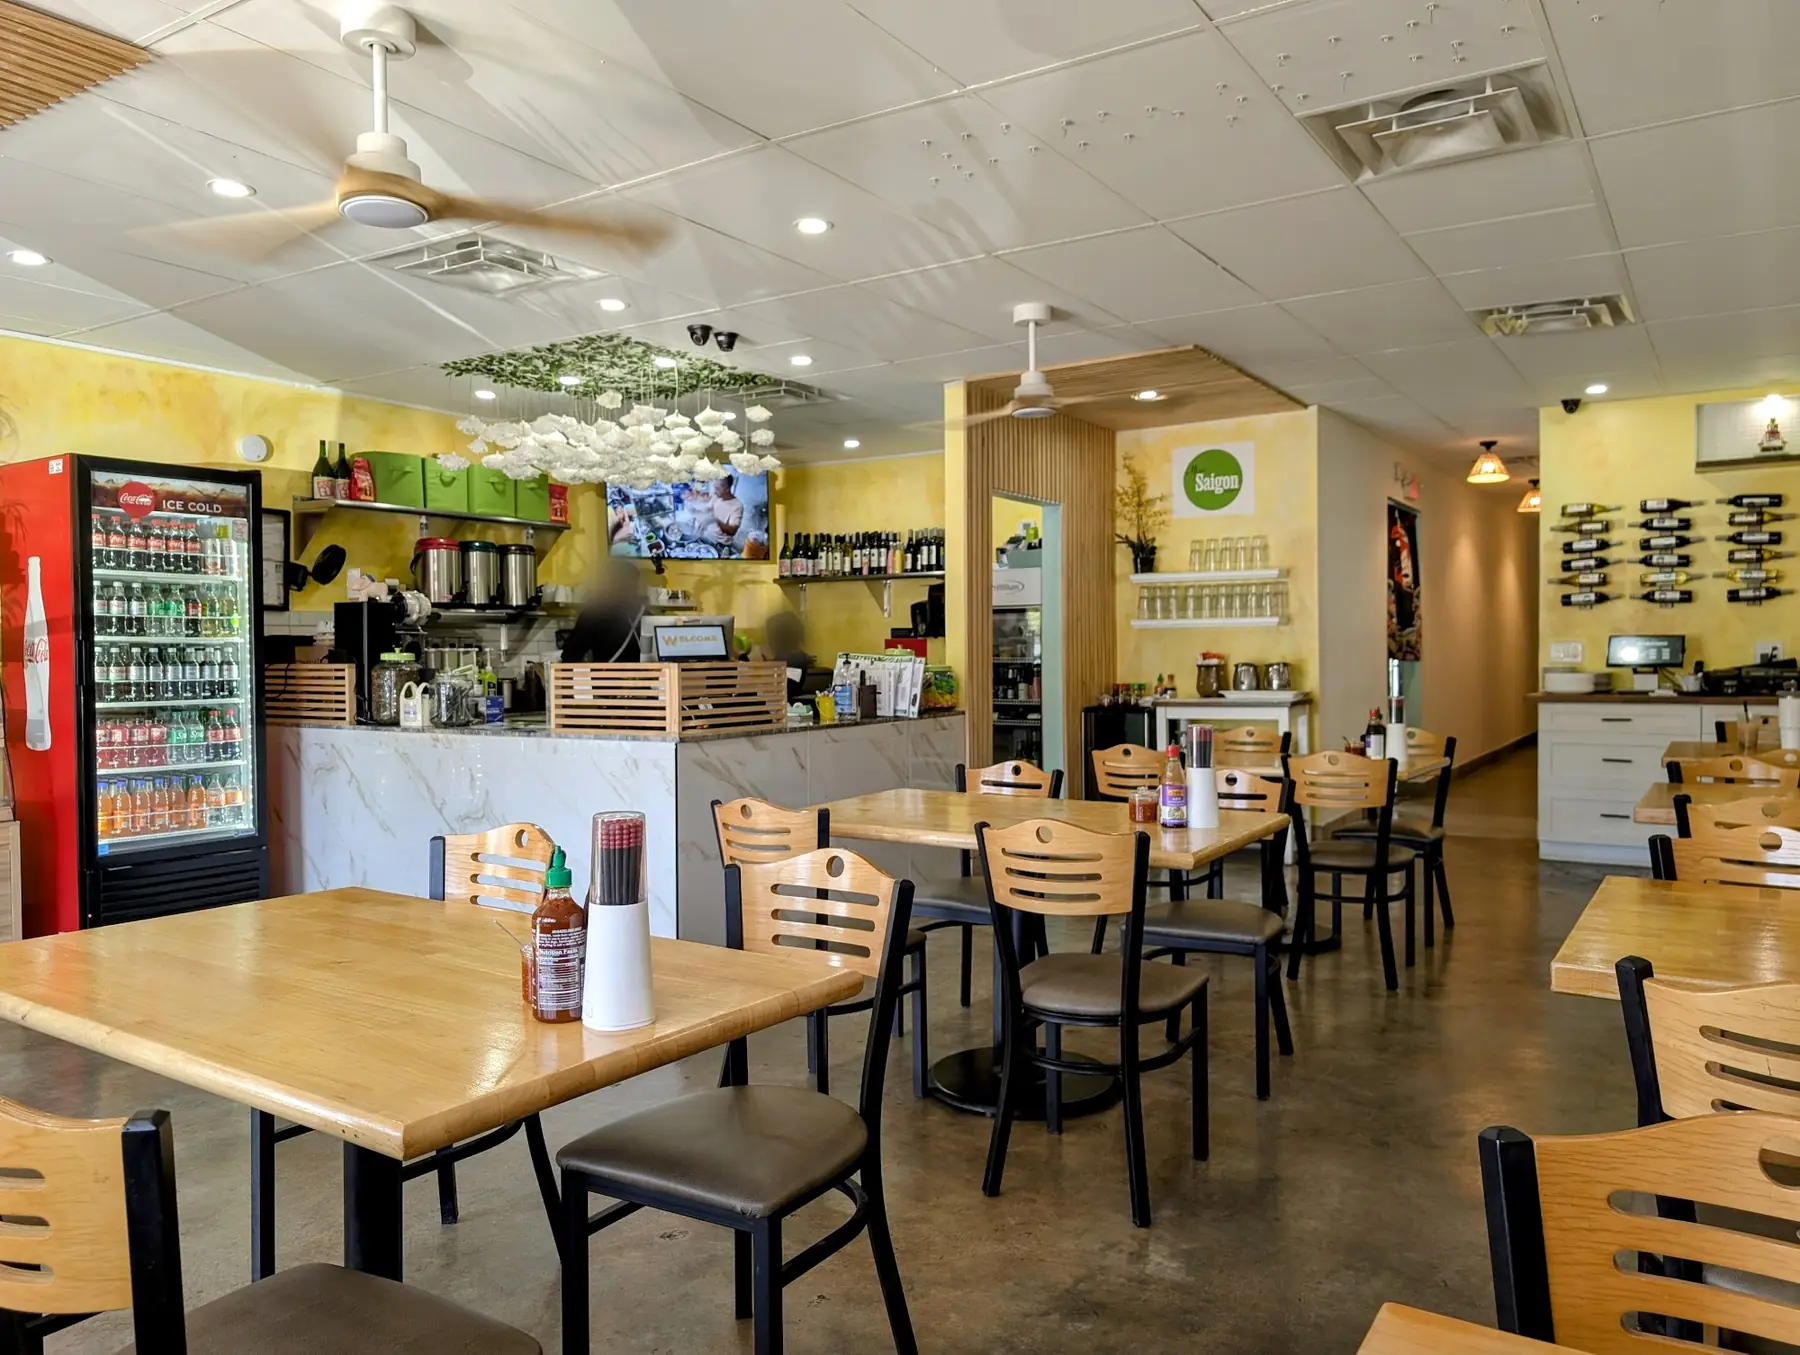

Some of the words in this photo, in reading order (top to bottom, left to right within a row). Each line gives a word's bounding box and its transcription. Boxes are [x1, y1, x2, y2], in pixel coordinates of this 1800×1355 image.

[1195, 473, 1239, 494] Saigon
[162, 499, 184, 511] ICE
[188, 501, 222, 513] COLD
[662, 635, 718, 647] WELCOME
